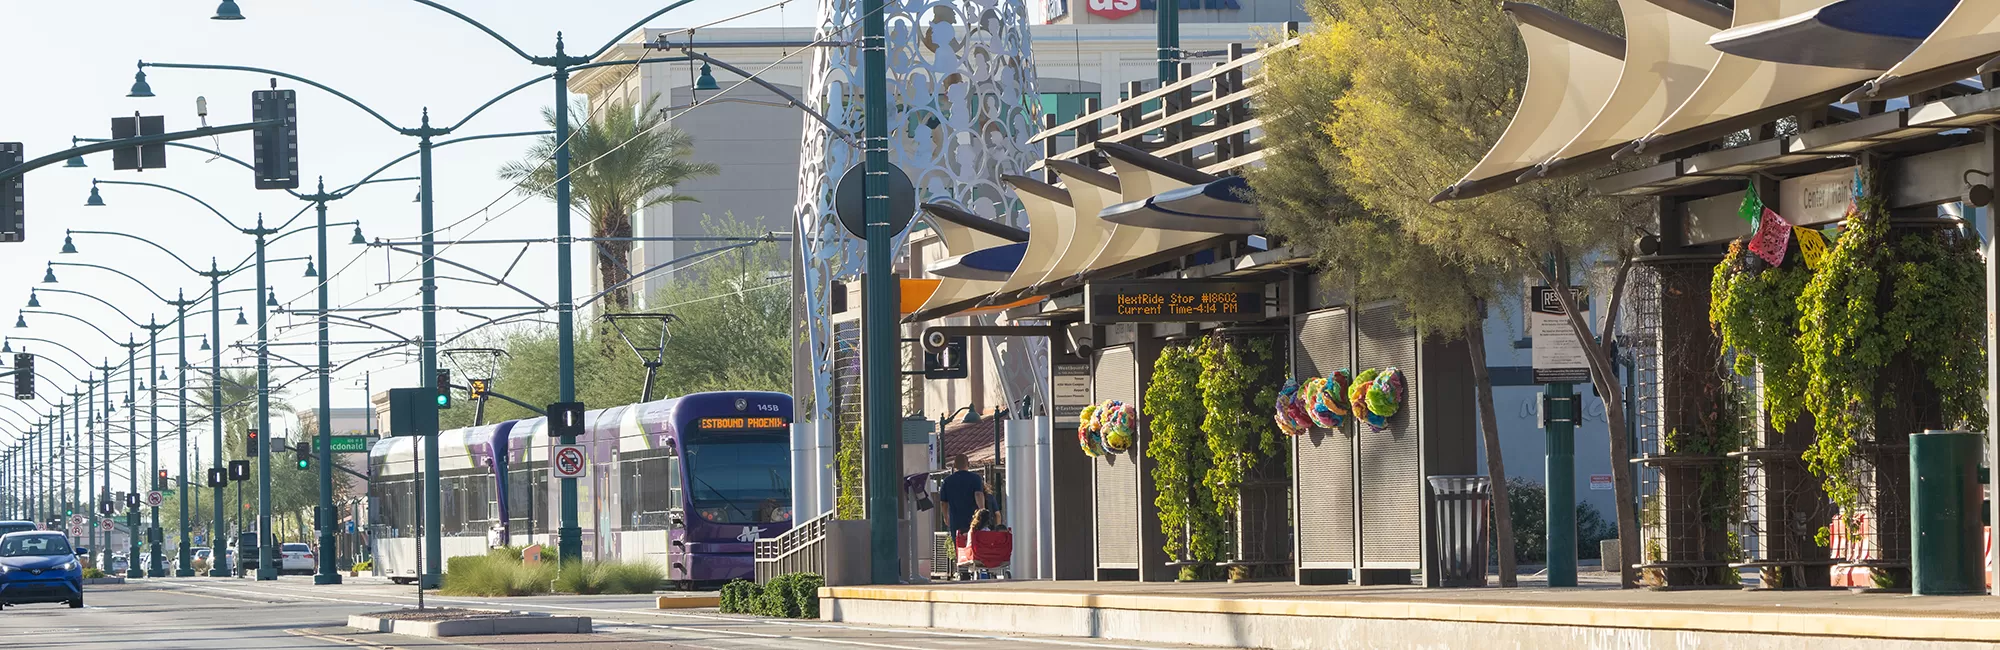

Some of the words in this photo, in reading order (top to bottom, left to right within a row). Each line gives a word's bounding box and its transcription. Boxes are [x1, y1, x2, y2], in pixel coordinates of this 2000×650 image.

[1804, 187, 1825, 209] Center
[1832, 180, 1848, 205] Main
[1117, 294, 1165, 305] NextRide
[1170, 293, 1195, 304] Stop
[1201, 292, 1238, 303] #18602
[1117, 304, 1162, 315] Current
[1223, 303, 1238, 314] PM
